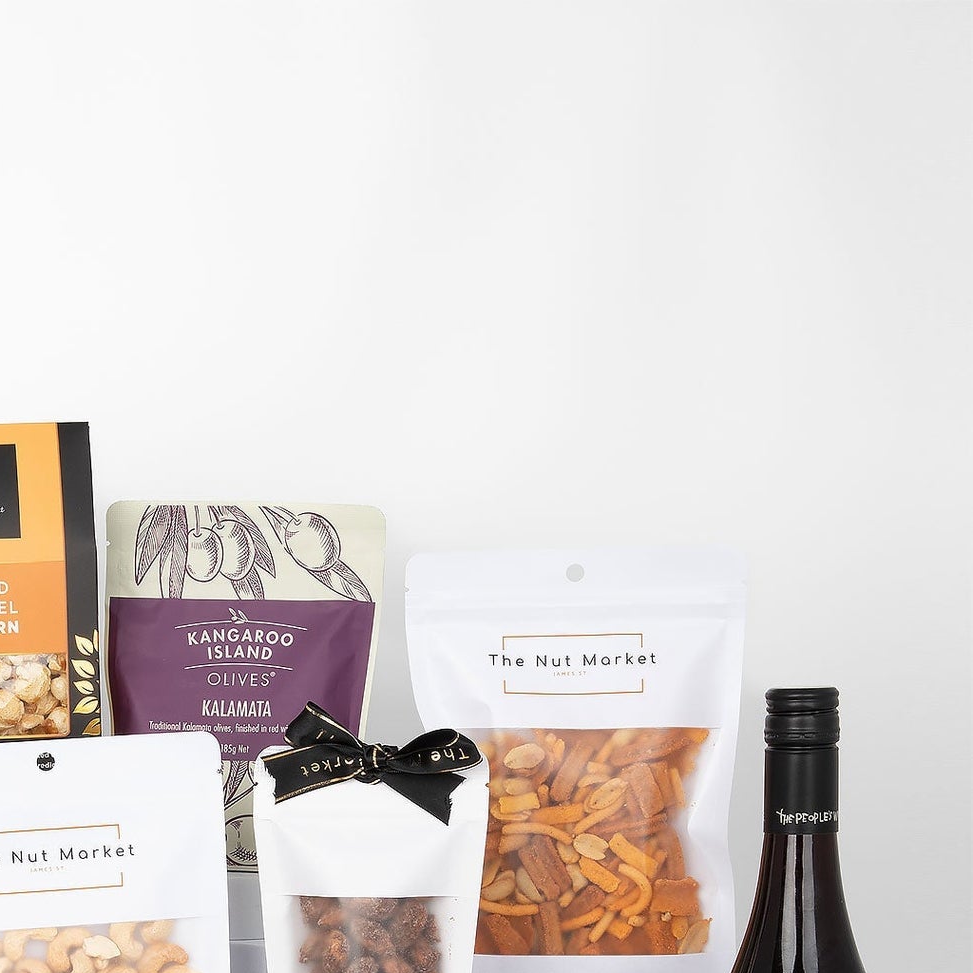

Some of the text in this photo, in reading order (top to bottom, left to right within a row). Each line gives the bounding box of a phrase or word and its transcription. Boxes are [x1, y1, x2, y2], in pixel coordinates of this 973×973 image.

[187, 628, 294, 647] KANGAROO
[207, 645, 273, 660] ISLAND
[488, 652, 657, 668] The Nut Market
[201, 700, 272, 717] KALAMATA
[149, 720, 279, 734] Traditional Kalamata olives, finished in red
[11, 850, 48, 864] Nut
[59, 844, 135, 862] Market
